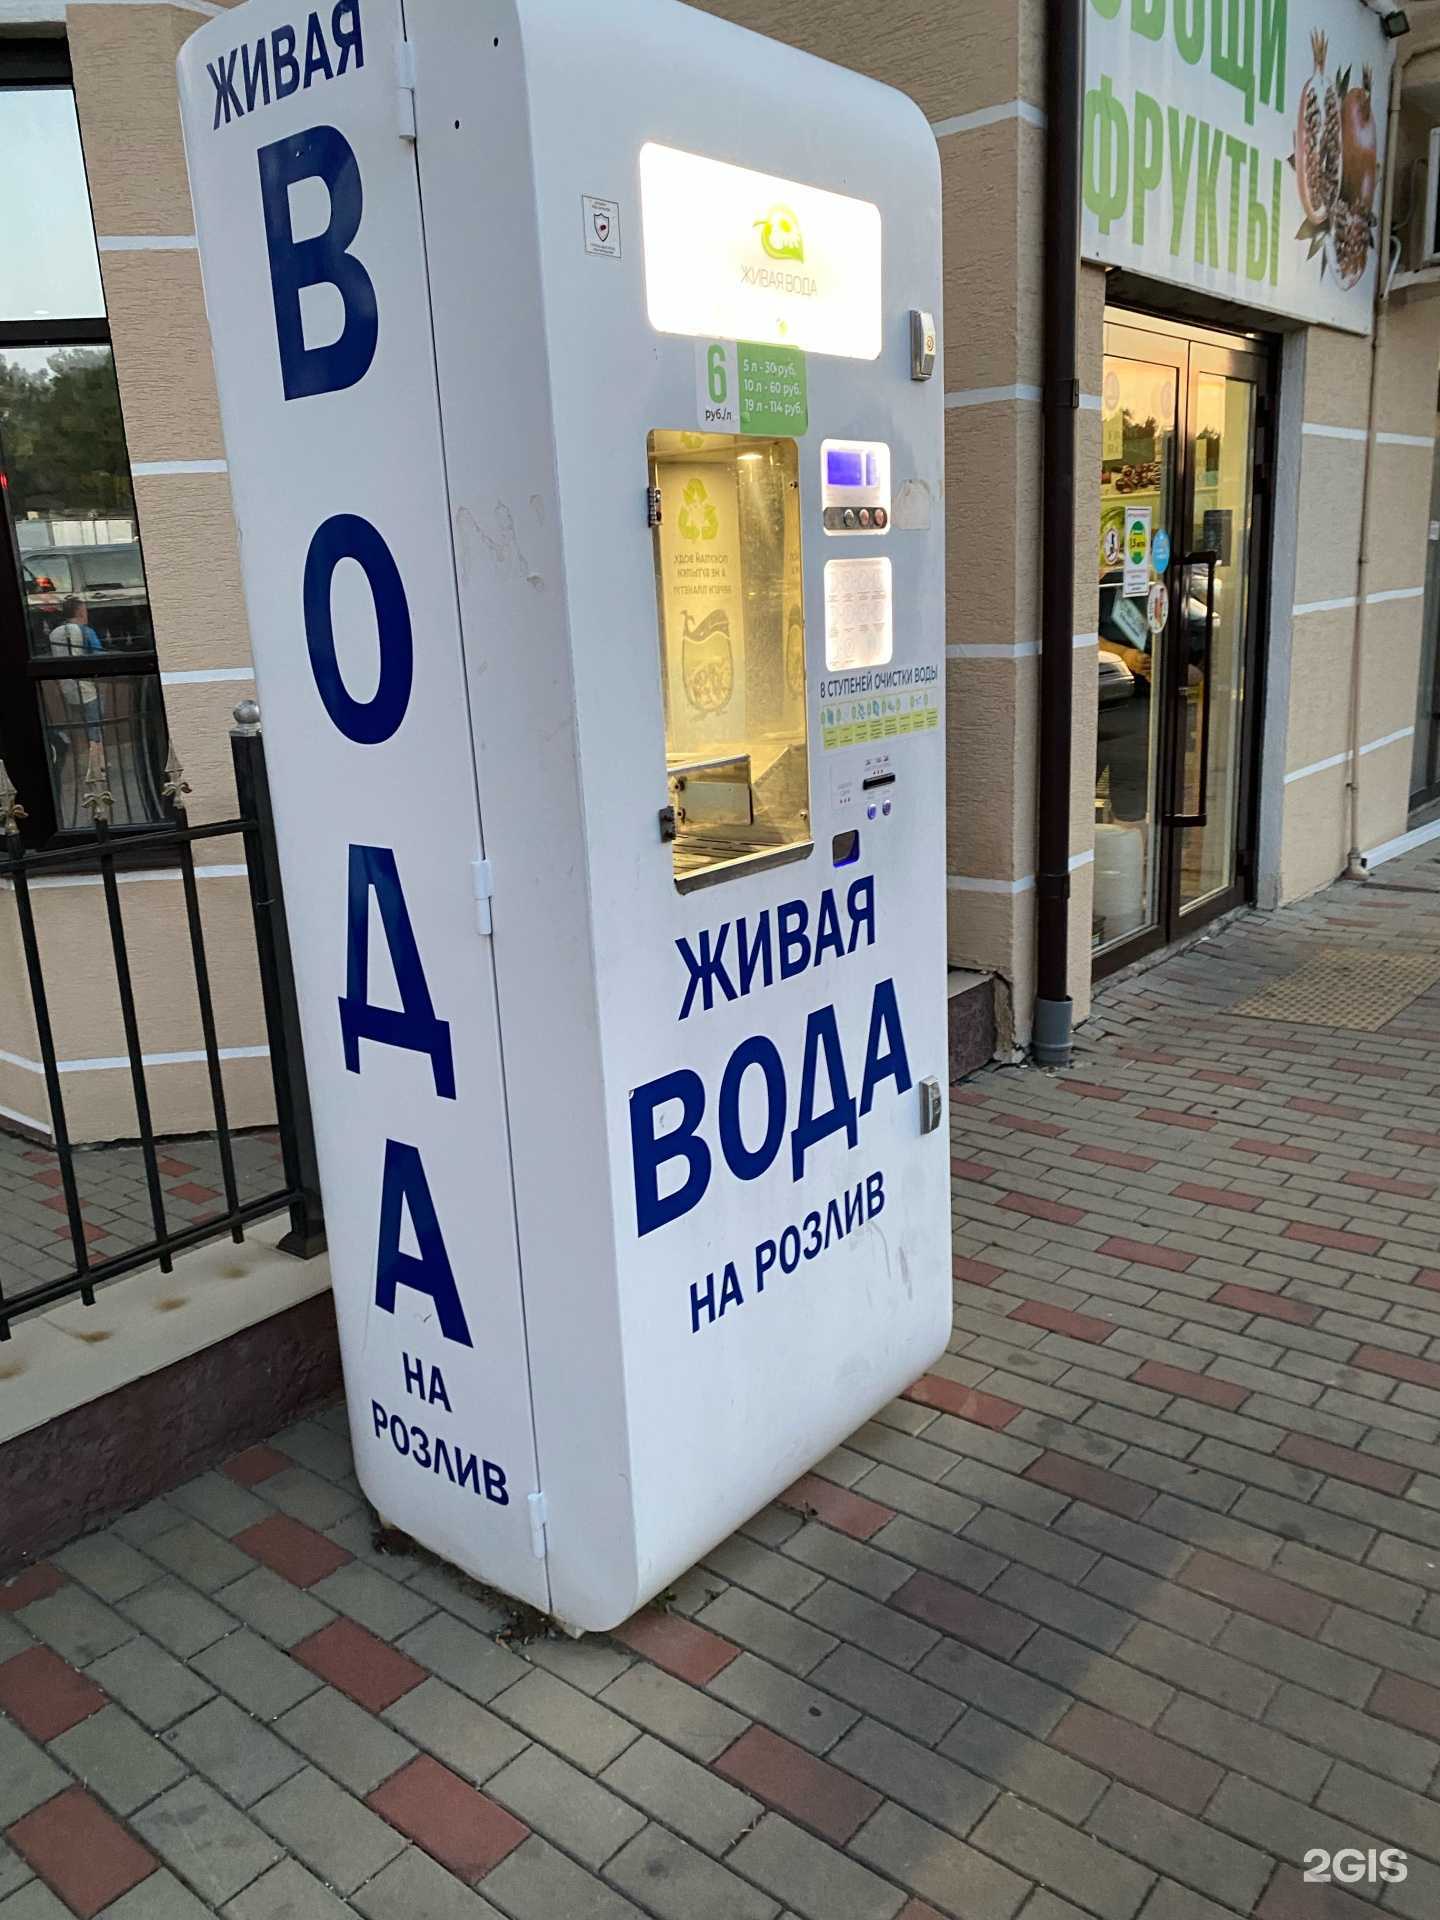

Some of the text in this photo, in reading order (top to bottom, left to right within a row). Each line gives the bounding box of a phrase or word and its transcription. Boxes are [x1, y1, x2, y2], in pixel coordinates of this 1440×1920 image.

[207, 0, 364, 130] ЖИВАЯ
[1084, 73, 1282, 287] ФРУКТЫ
[741, 264, 818, 297] ЖИВАЯ ВОДА
[707, 343, 727, 404] 6
[743, 359, 750, 372] 5
[765, 361, 777, 374] 30
[744, 379, 754, 392] 10
[756, 384, 762, 393] л
[770, 382, 781, 393] 60
[705, 408, 732, 421] руб./л
[745, 399, 753, 411] 19
[827, 672, 873, 697] СТУПЕНЕЙ
[874, 669, 913, 689] ОЧИСТКИ
[914, 666, 938, 684] ВОДЫ
[674, 875, 876, 1021] ЖИВАЯ
[629, 977, 912, 1238] ВОДА
[689, 1170, 885, 1334] НА РОЗЛИВ
[402, 1351, 453, 1414] НА
[371, 1400, 509, 1506] РОЗЛИВ
